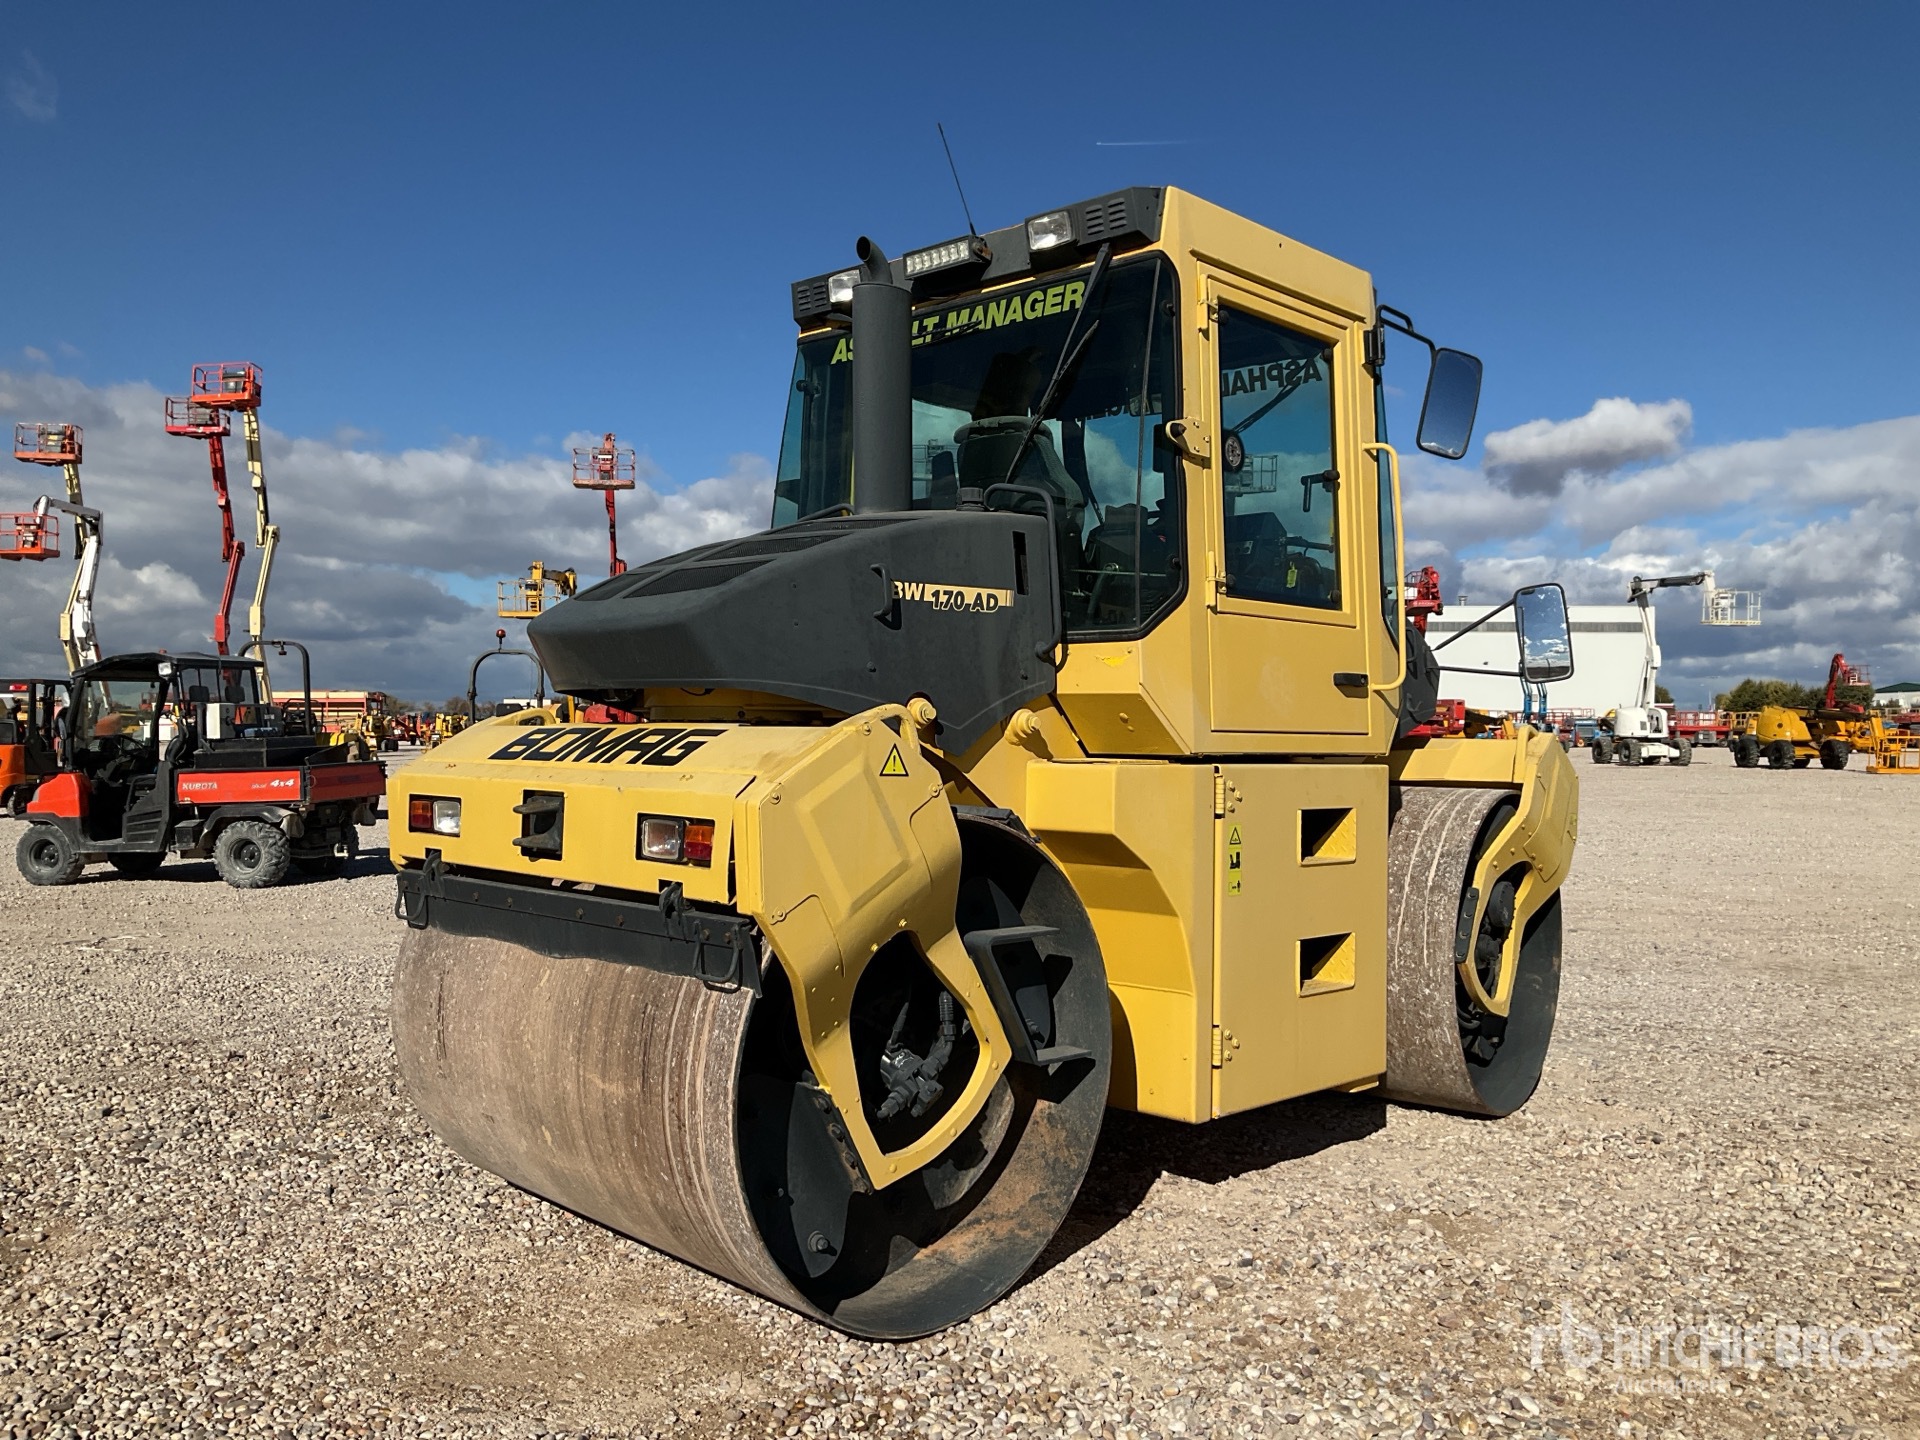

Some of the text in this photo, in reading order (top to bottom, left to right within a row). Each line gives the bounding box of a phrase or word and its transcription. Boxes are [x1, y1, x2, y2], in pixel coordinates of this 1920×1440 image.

[944, 281, 1086, 336] MANAGER
[891, 580, 999, 613] BW 170 AD
[487, 727, 729, 767] BOMAG
[182, 781, 218, 791] KUBOTA
[269, 778, 295, 788] 4x4
